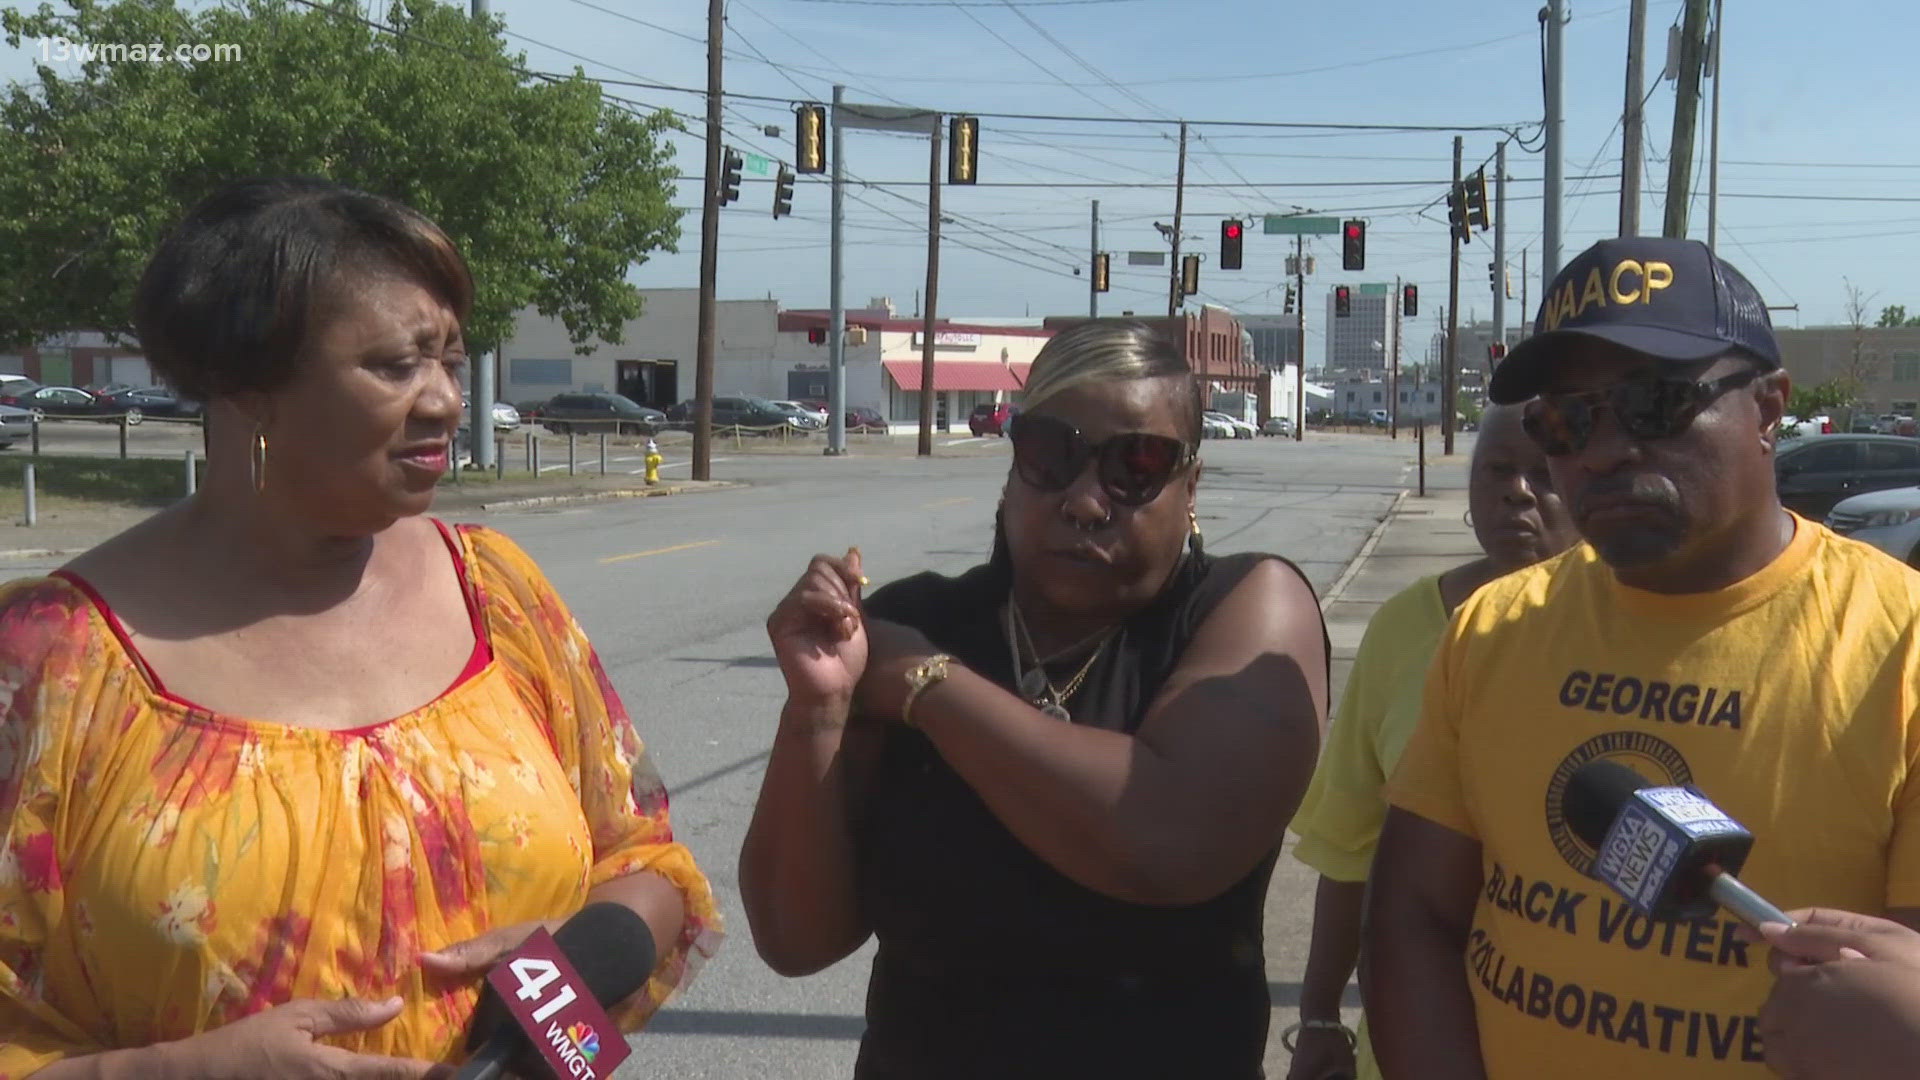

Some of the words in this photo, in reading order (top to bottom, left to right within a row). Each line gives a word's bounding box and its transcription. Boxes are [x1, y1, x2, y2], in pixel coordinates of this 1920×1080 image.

[1543, 259, 1674, 332] NAACP
[1559, 670, 1742, 729] GEORGIA
[1603, 816, 1643, 877] WGXA
[1619, 827, 1660, 891] NEWS
[1486, 862, 1587, 936] BLACK
[1597, 897, 1750, 968] VOTER
[508, 958, 577, 1024] 41
[1470, 929, 1766, 1063] COLLABORATIVE
[545, 1020, 596, 1080] WMGT
